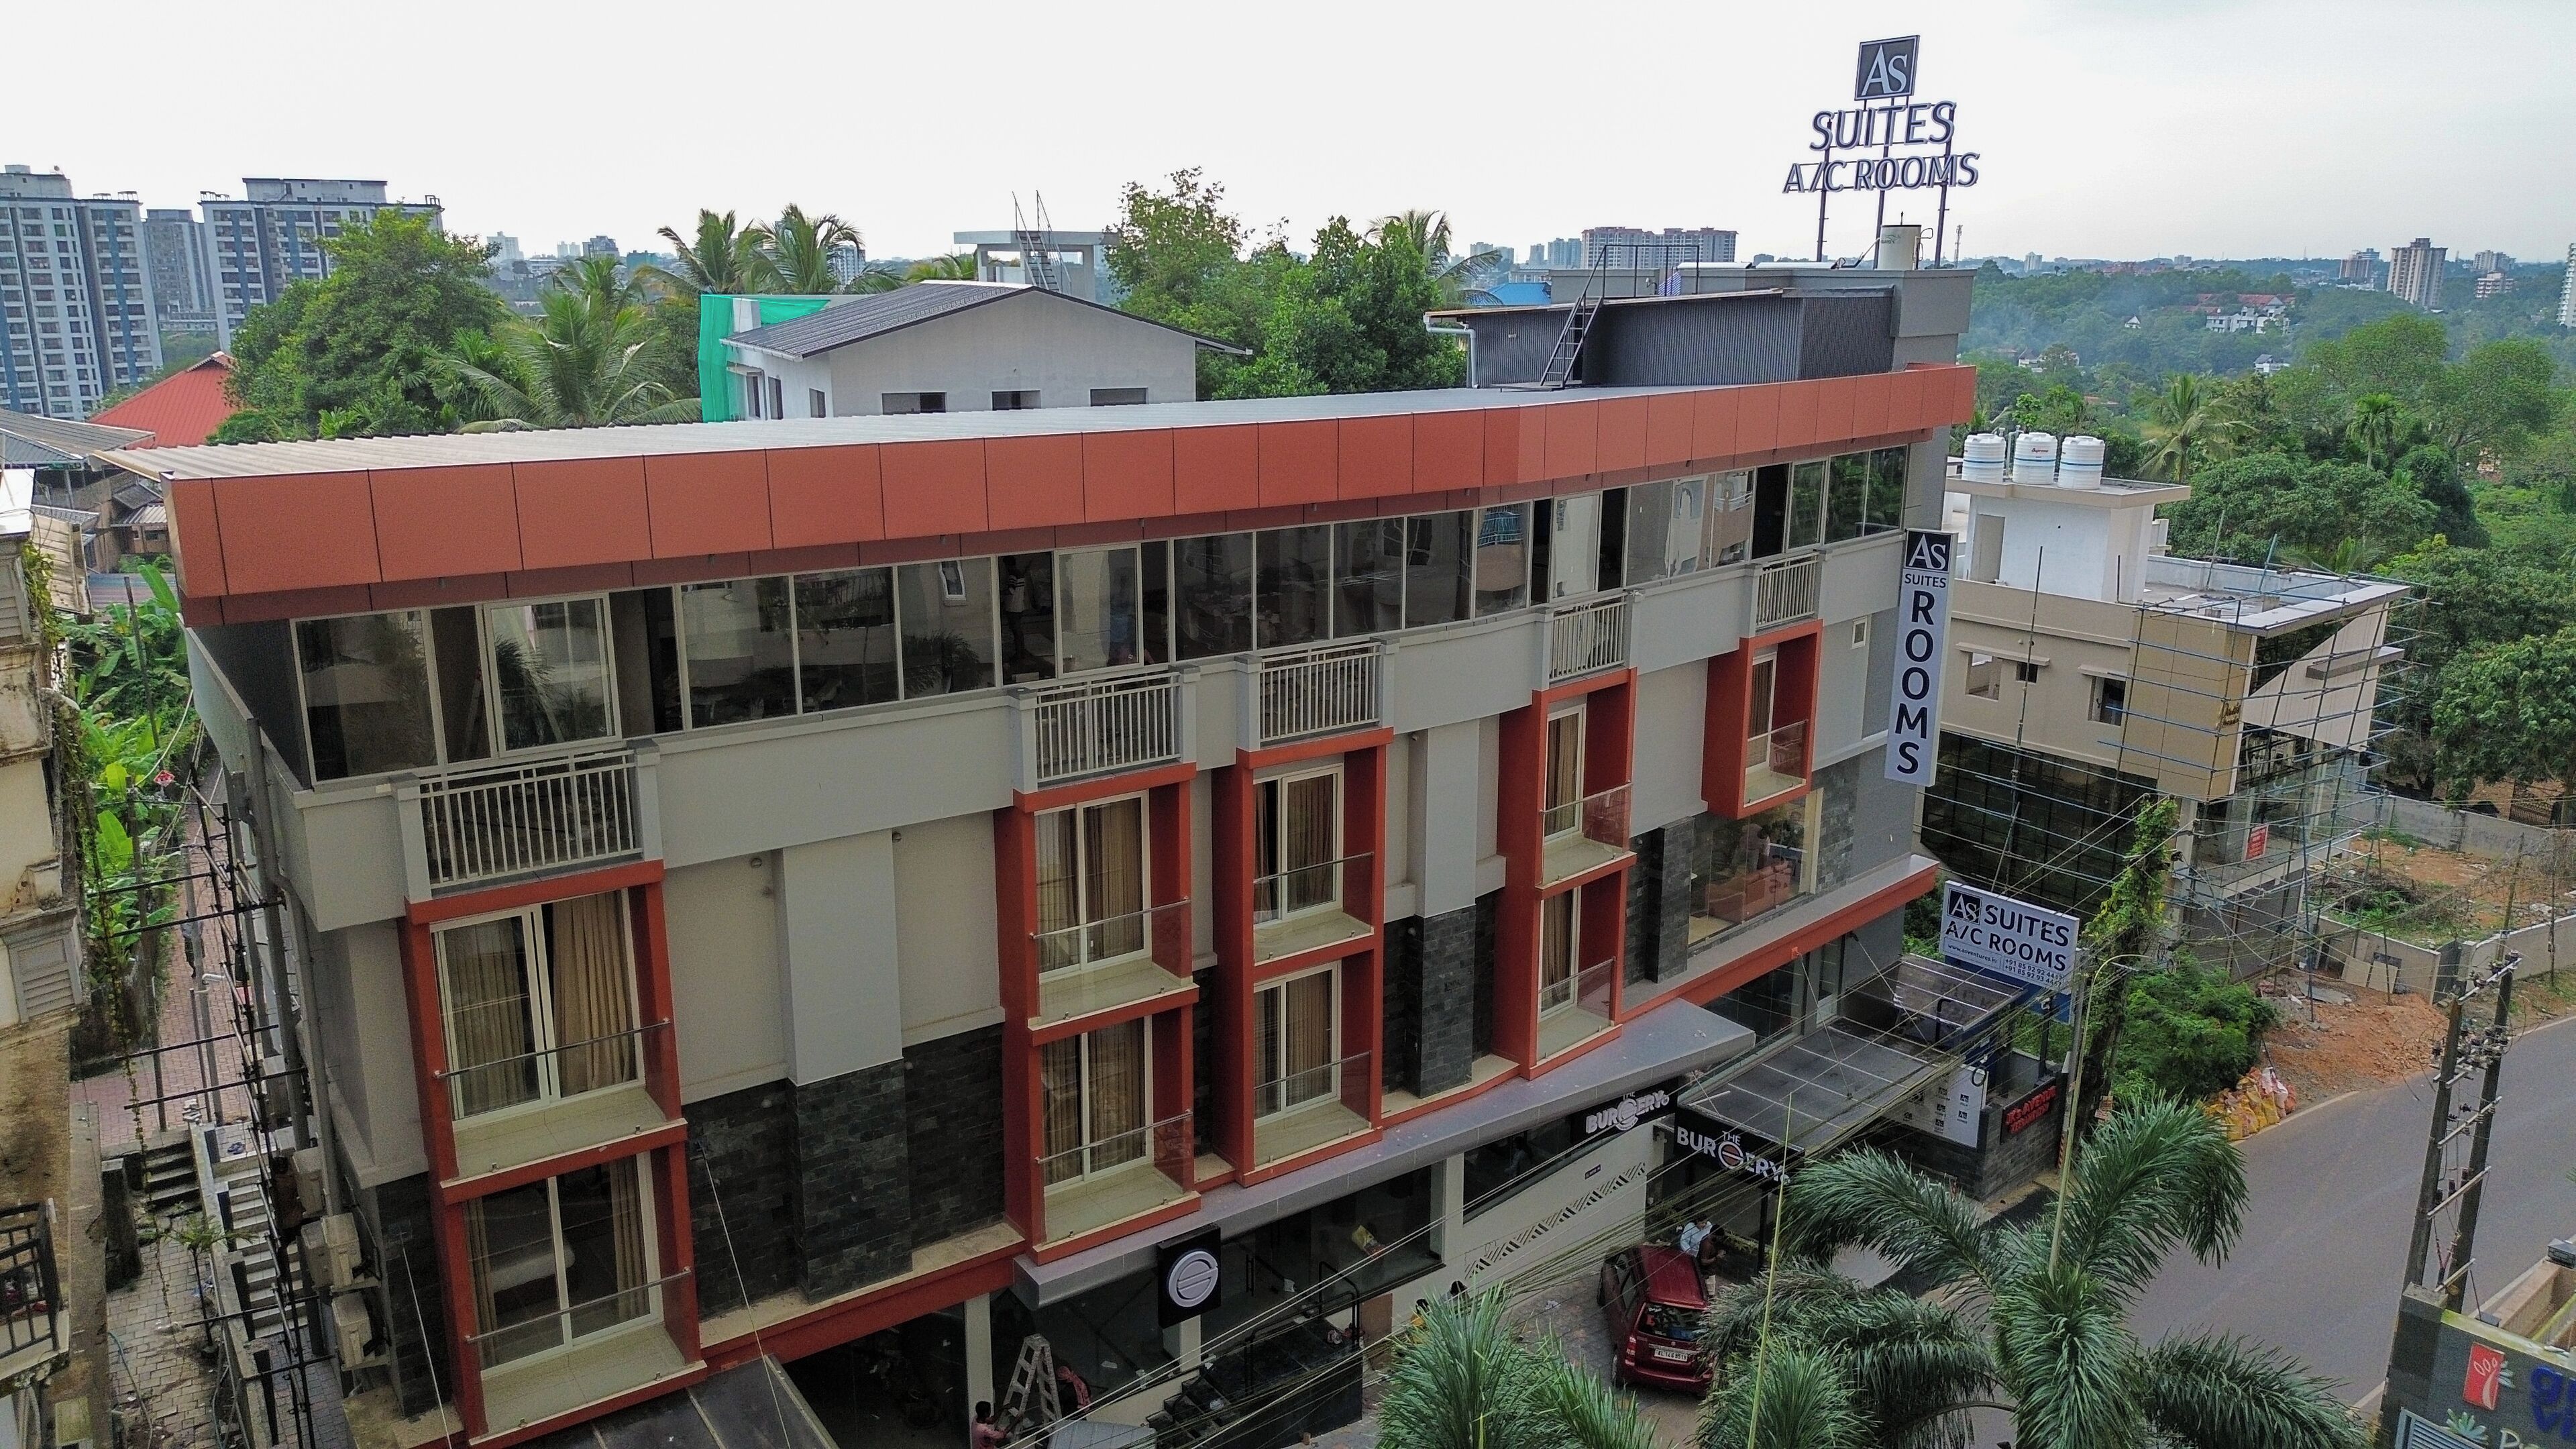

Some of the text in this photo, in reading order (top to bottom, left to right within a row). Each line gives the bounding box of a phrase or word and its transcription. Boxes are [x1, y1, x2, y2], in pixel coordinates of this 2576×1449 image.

[1861, 44, 1908, 95] AS
[1809, 101, 1957, 151] SUITES
[1782, 152, 1980, 193] A/C ROOMS
[1909, 533, 1946, 570] AS
[1904, 573, 1946, 588] SUITES
[1894, 590, 1935, 774] ROOMS
[1945, 920, 2067, 972] A/C ROOMS
[1984, 904, 2070, 947] SUITES
[1722, 1130, 1741, 1146] THE
